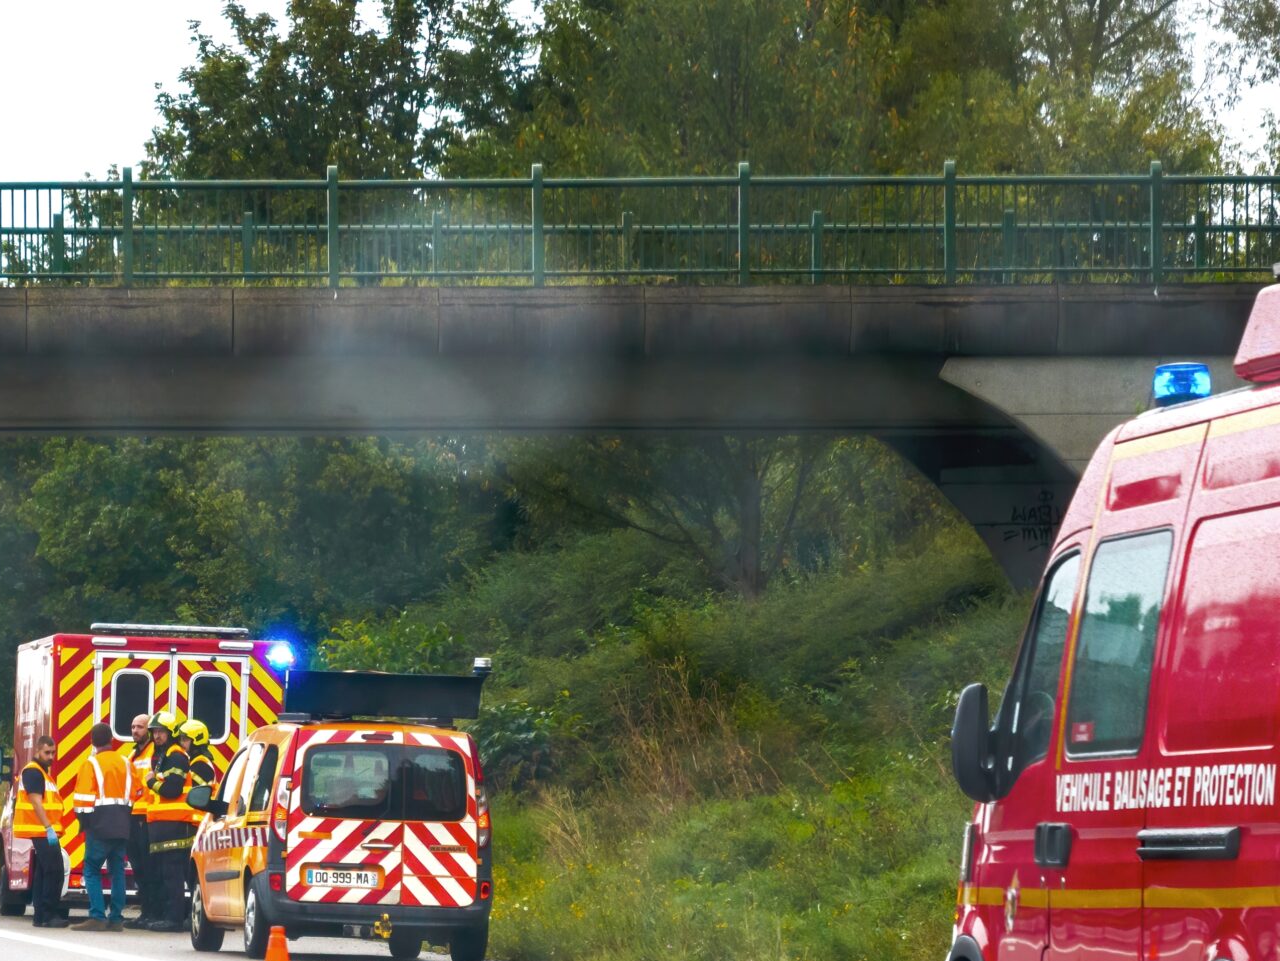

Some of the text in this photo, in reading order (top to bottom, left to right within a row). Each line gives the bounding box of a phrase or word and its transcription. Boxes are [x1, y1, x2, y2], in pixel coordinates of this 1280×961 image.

[1056, 763, 1277, 812] VEHICULE BALISAGE ET PROTECTION
